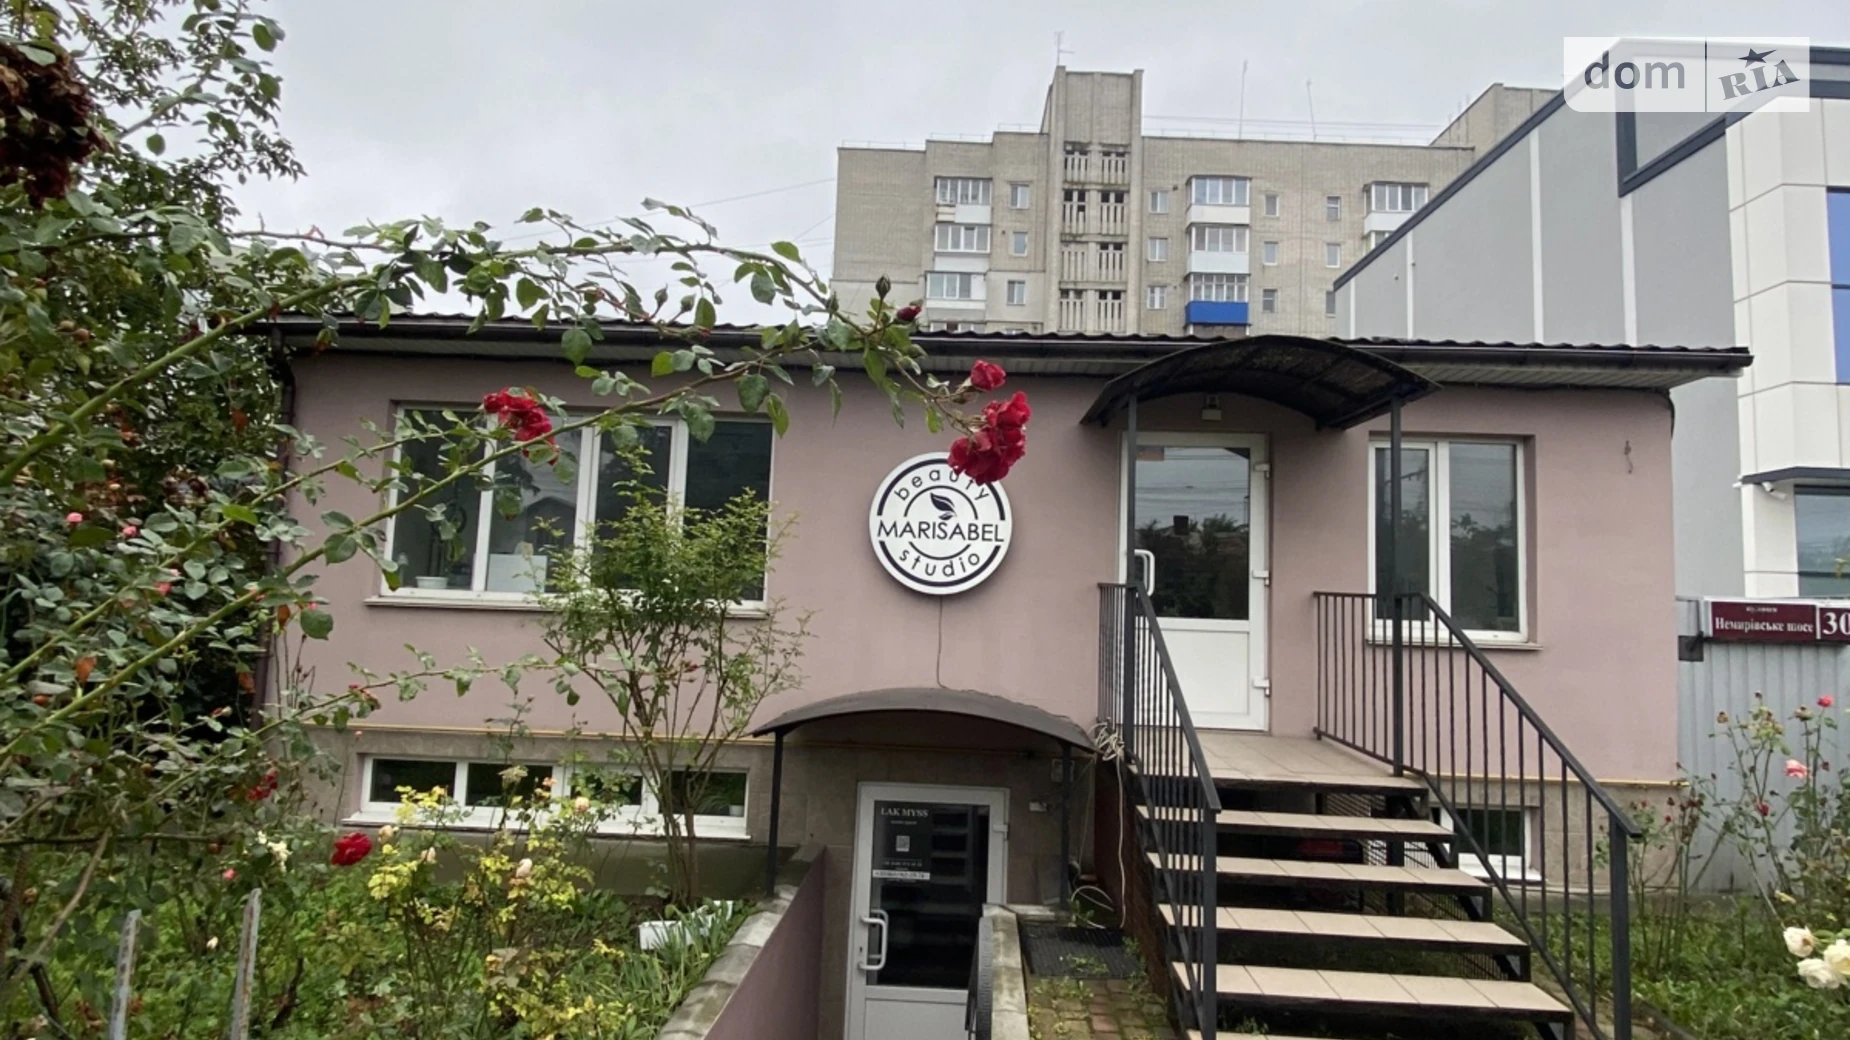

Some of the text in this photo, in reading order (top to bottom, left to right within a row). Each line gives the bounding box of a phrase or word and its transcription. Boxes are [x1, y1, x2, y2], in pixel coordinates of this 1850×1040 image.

[877, 520, 1005, 543] MARISABEL
[899, 549, 980, 578] studio
[1715, 617, 1814, 634] Немирівське шосе
